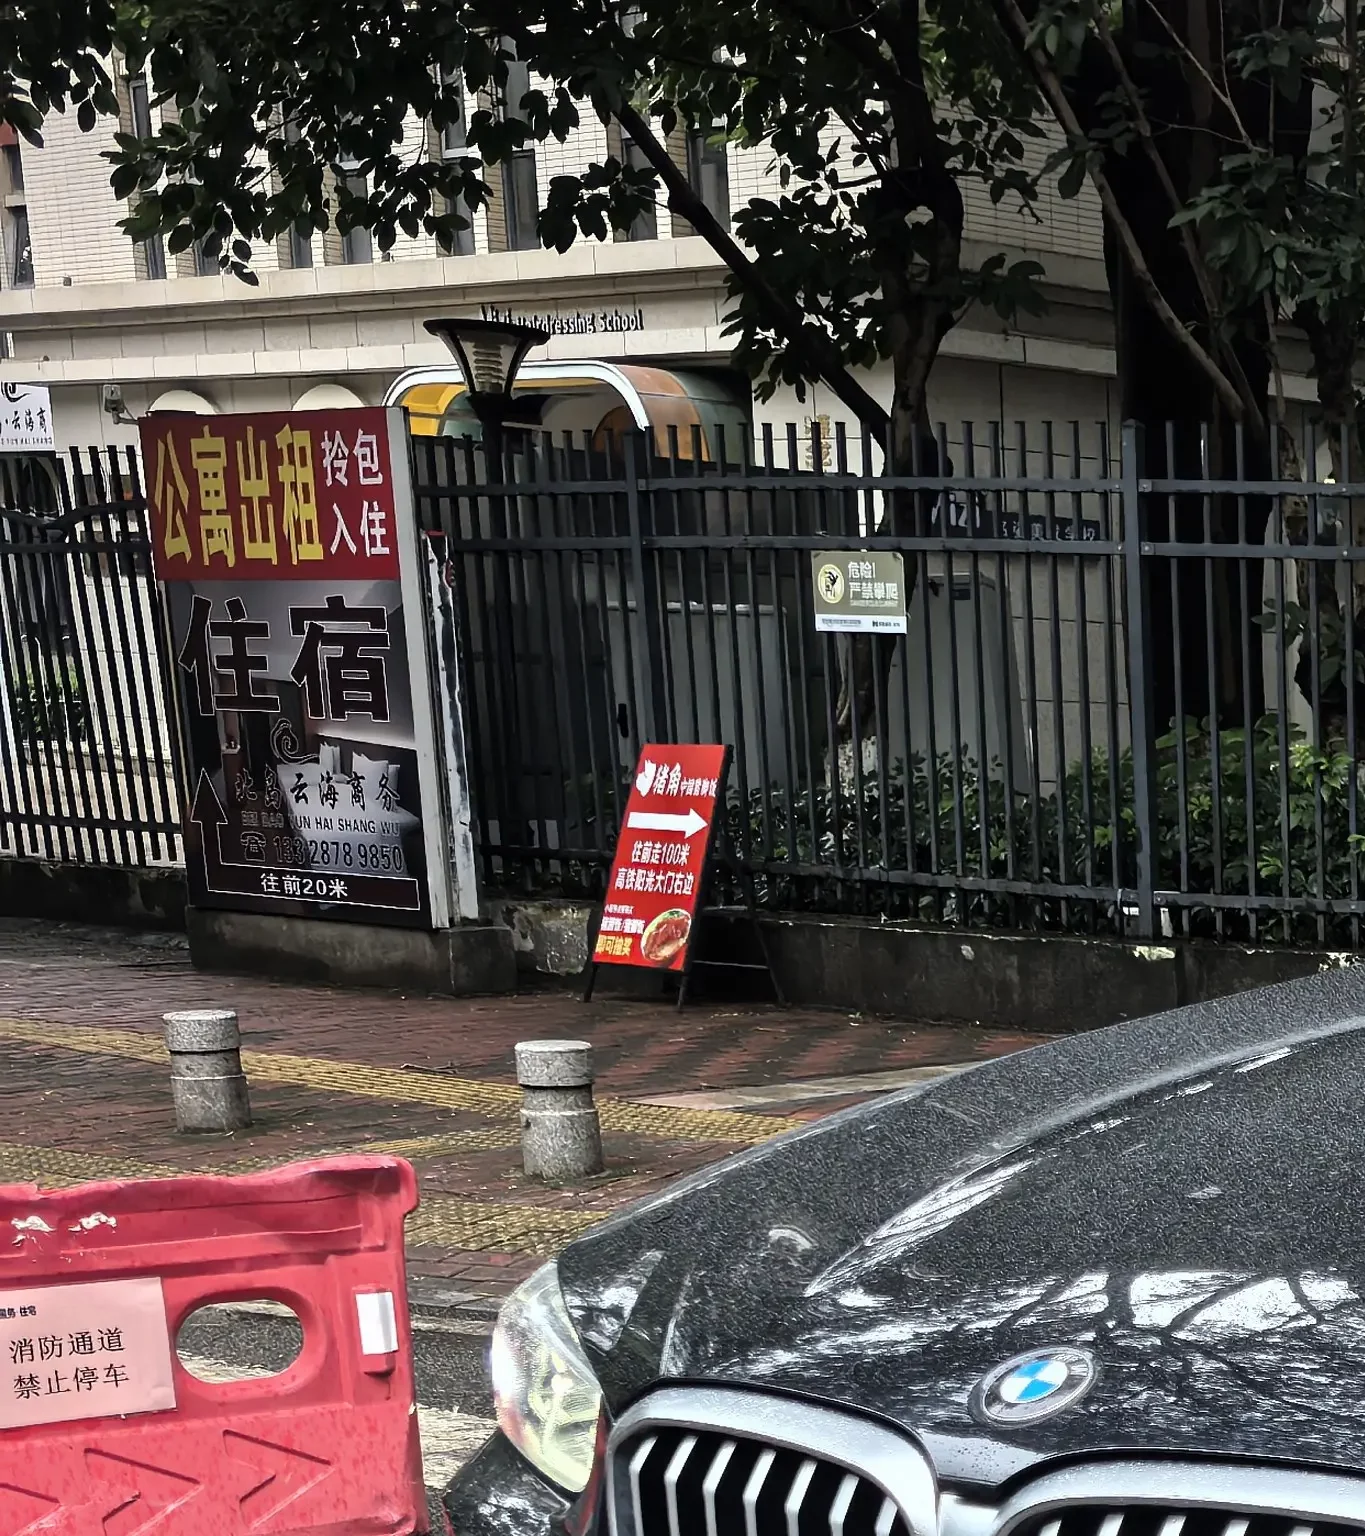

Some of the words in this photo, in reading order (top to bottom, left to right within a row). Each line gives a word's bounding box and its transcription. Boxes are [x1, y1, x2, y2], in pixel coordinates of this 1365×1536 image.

[599, 308, 645, 332] School
[320, 428, 384, 488] 拎包
[154, 423, 325, 568] 公寓出租
[330, 499, 390, 558] 入住
[178, 594, 391, 723] 住宿
[315, 816, 334, 831] HAI
[338, 818, 376, 834] SHANG
[380, 822, 401, 837] WU
[309, 840, 353, 867] 2878
[357, 843, 404, 873] 9850
[631, 840, 691, 867] 往前走100米
[260, 873, 349, 899] 往前20米
[8, 1327, 126, 1364] 消防通道
[13, 1363, 130, 1400] 禁止停车
